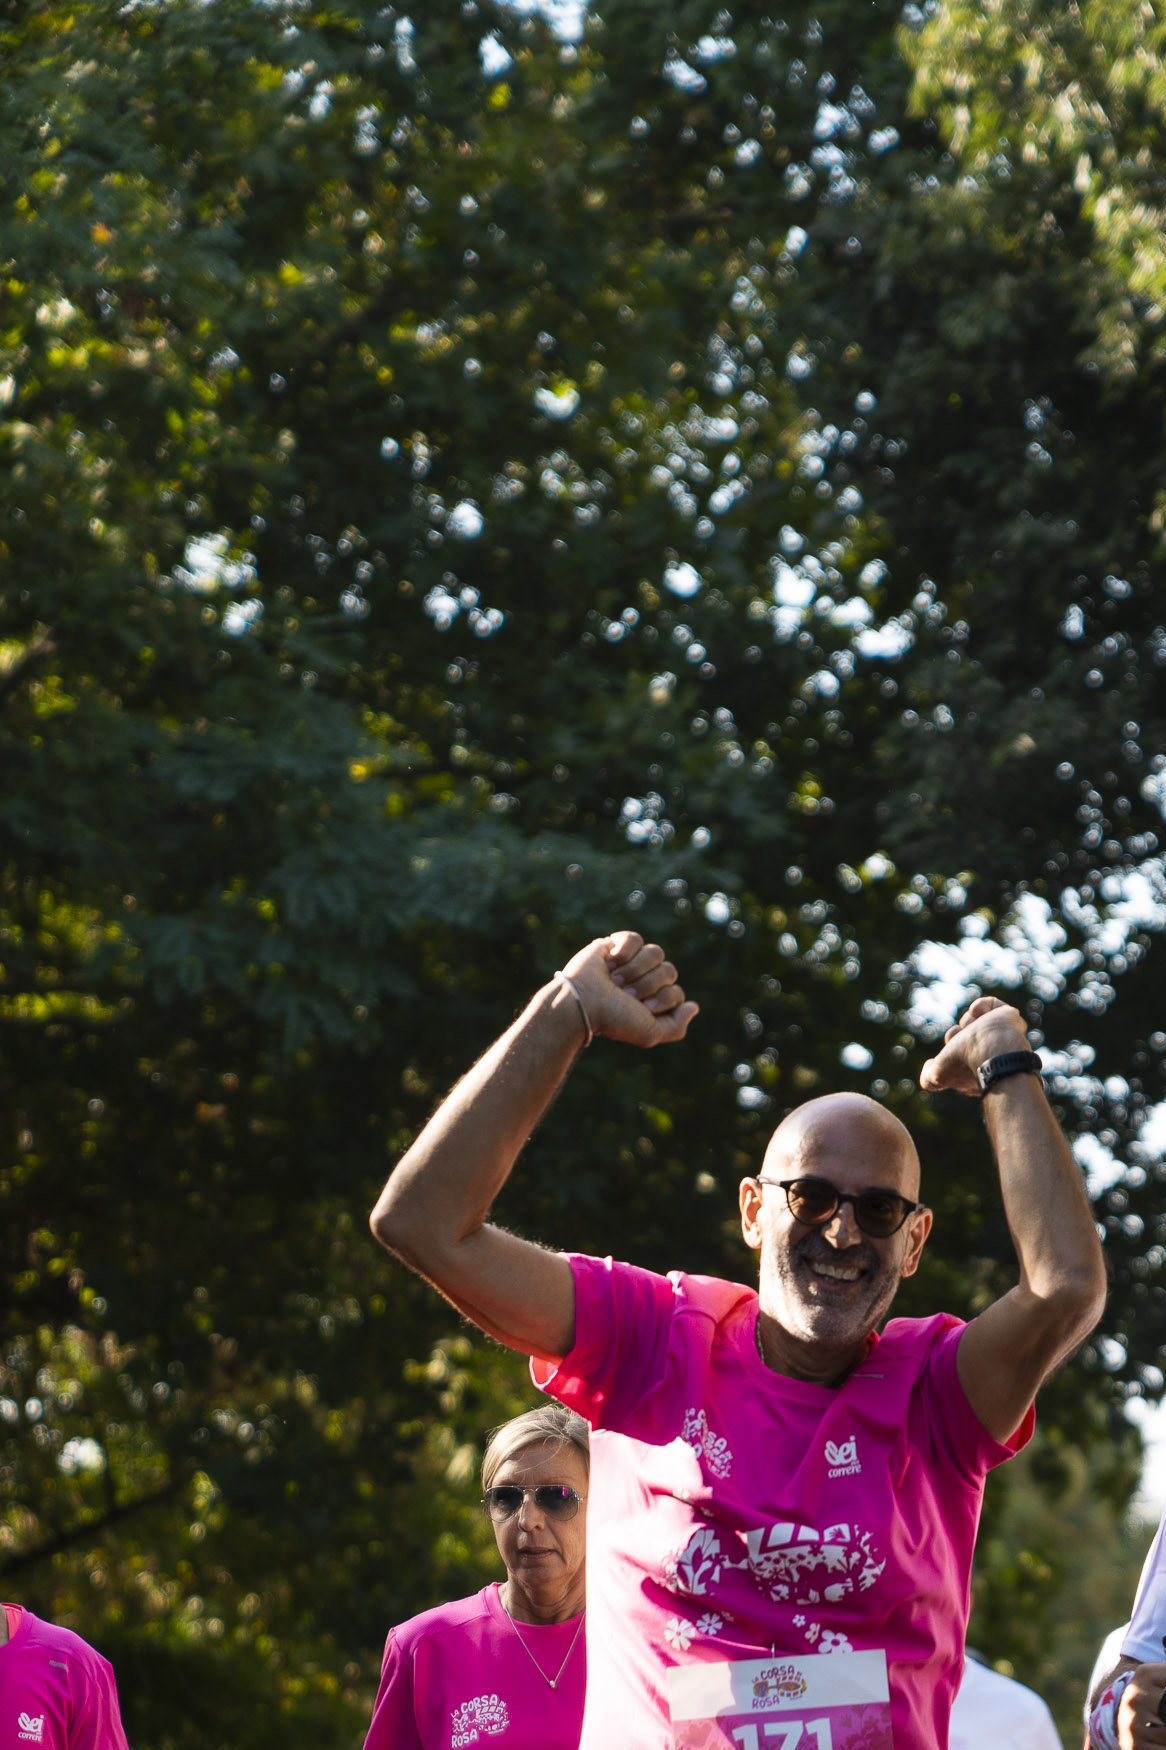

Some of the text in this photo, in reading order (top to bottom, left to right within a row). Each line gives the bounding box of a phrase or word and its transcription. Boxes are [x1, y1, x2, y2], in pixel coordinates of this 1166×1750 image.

[828, 1464, 862, 1479] correre
[760, 1665, 795, 1681] CORSA
[450, 1708, 460, 1719] LA
[460, 1694, 499, 1714] CORSA
[752, 1694, 780, 1709] ROSA
[451, 1728, 478, 1748] ROSA
